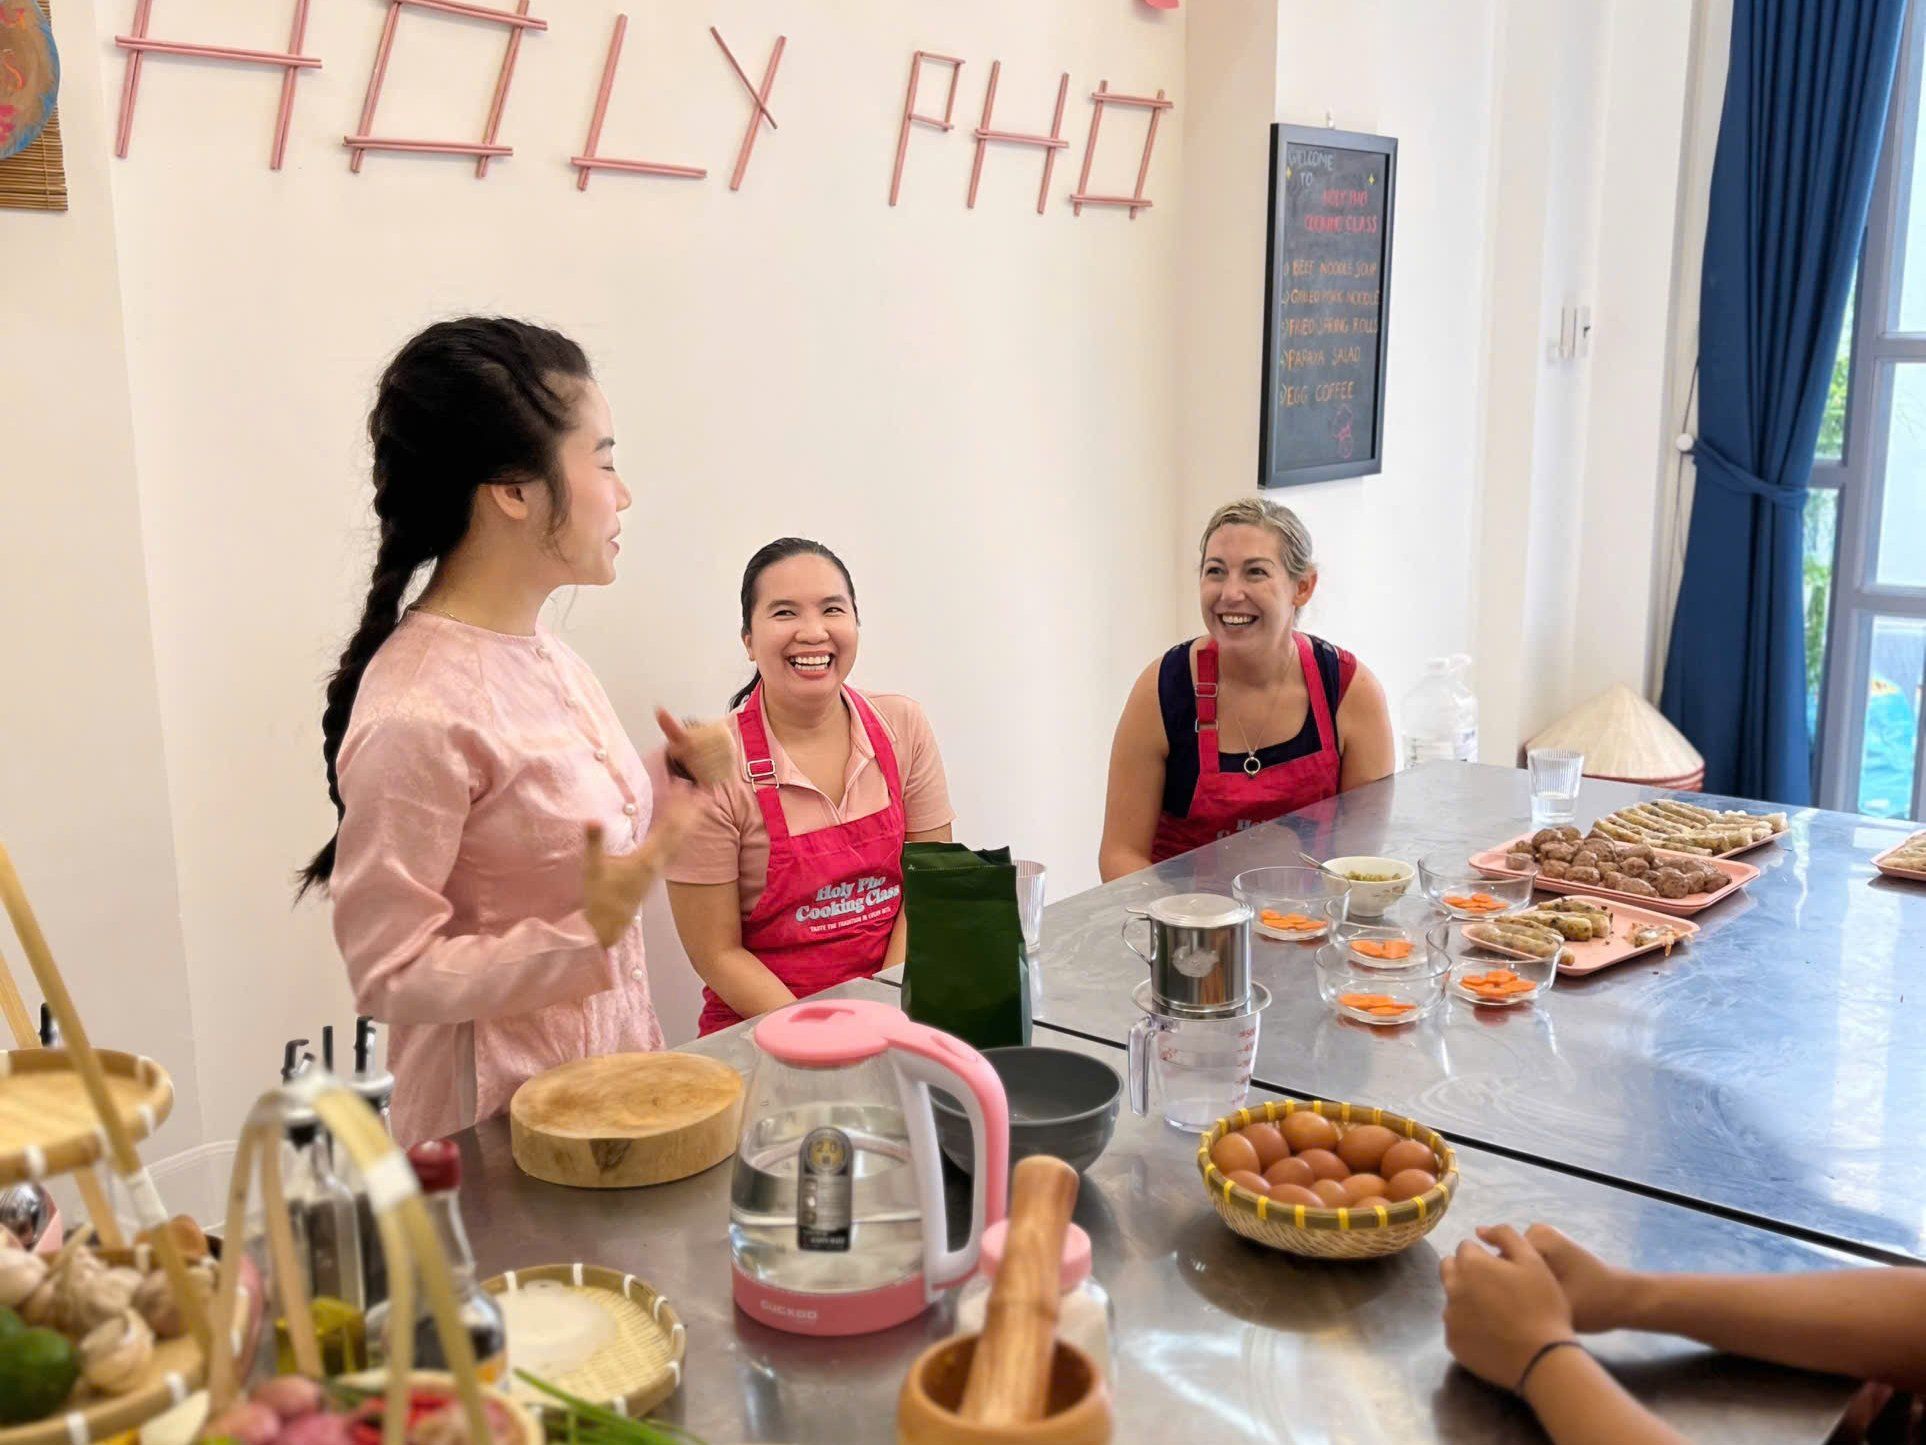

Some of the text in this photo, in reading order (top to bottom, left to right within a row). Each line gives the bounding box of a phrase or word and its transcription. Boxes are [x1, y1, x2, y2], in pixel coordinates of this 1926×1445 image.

[115, 0, 1174, 220] HOLY PHO
[1287, 150, 1335, 171] WELCOME
[1300, 172, 1313, 186] TO
[1345, 214, 1377, 234] CLASS
[1292, 259, 1314, 278] BEEF
[1319, 260, 1353, 276] NOODLE
[1354, 260, 1377, 278] SOUP
[1332, 346, 1361, 366] SALAD
[1287, 385, 1308, 407] EGG
[1315, 380, 1355, 402] COFFEE
[815, 876, 886, 902] Holy Pho
[795, 897, 865, 922] Cooking
